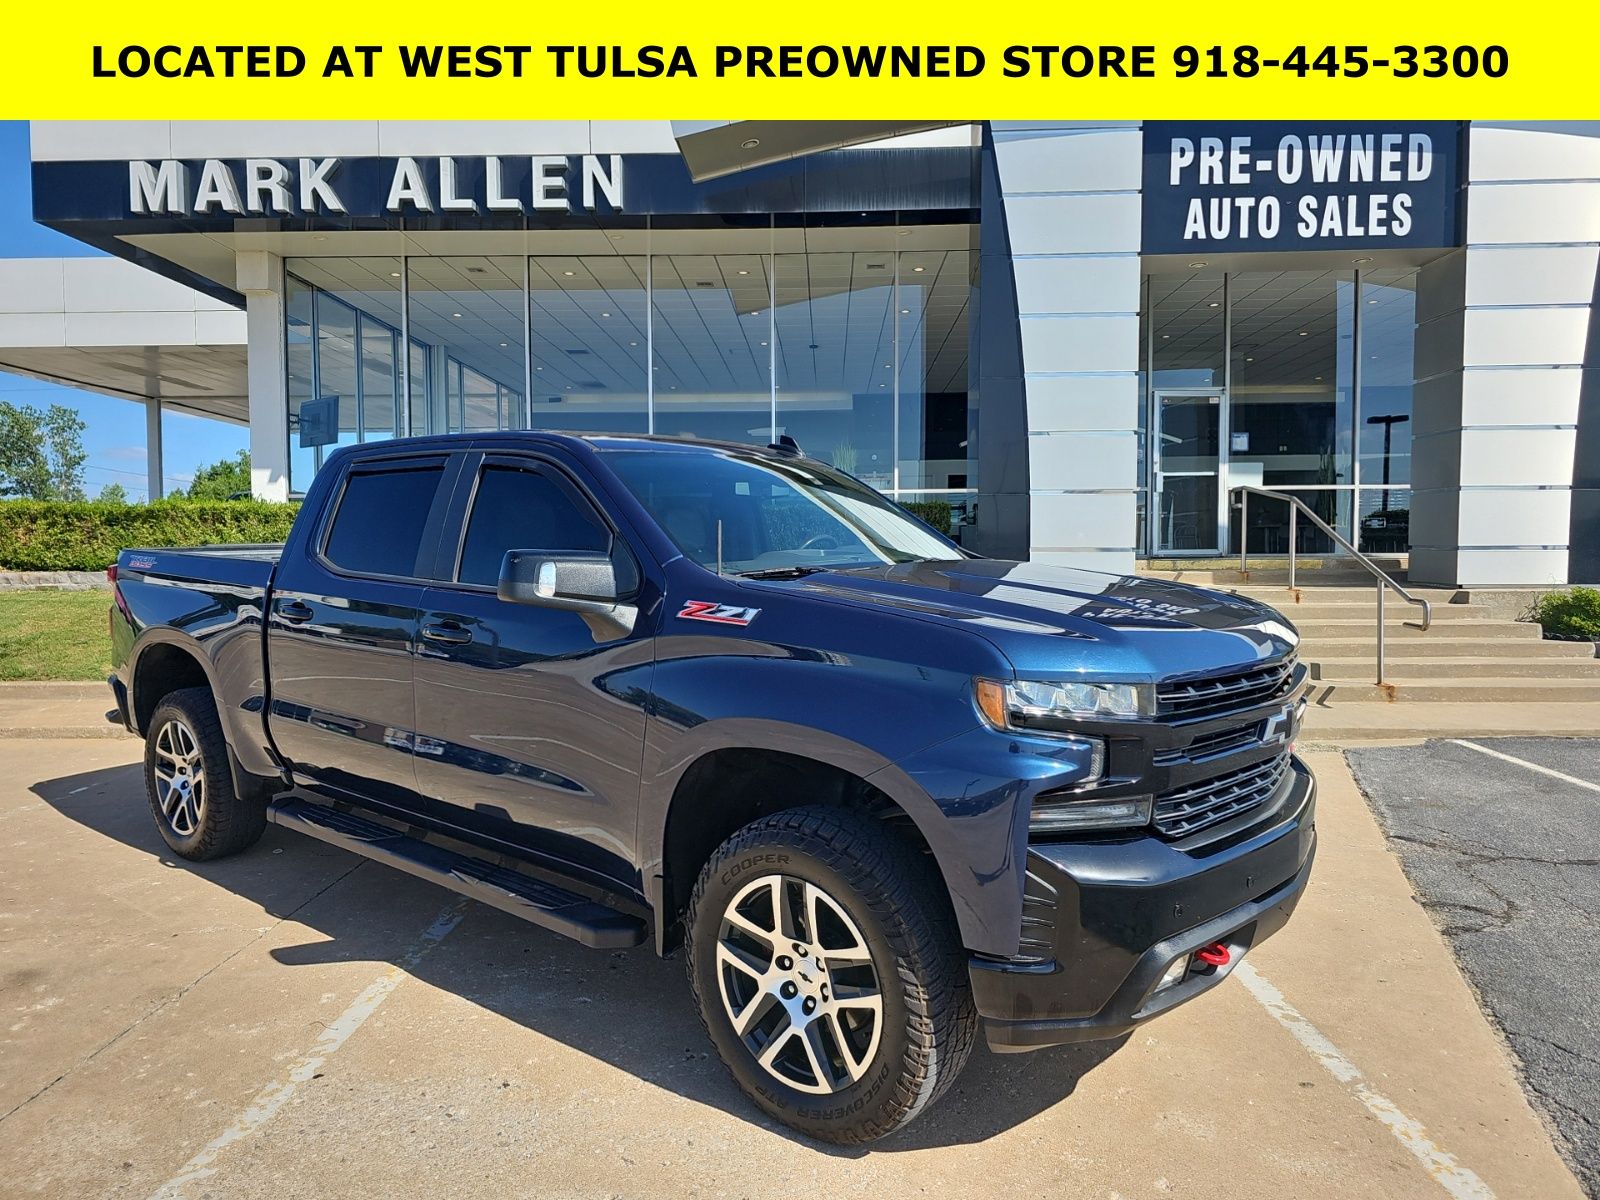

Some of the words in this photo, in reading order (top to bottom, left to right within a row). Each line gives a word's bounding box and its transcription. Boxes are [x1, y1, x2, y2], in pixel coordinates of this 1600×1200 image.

[1169, 133, 1433, 186] PRE-OWNED
[129, 158, 349, 217] MARK
[386, 154, 624, 215] ALLEN
[1183, 195, 1281, 240] AUTO
[1297, 193, 1413, 237] SALES
[675, 599, 762, 626] Z71
[721, 853, 791, 886] COOPER
[796, 1062, 890, 1121] DISCOVERER
